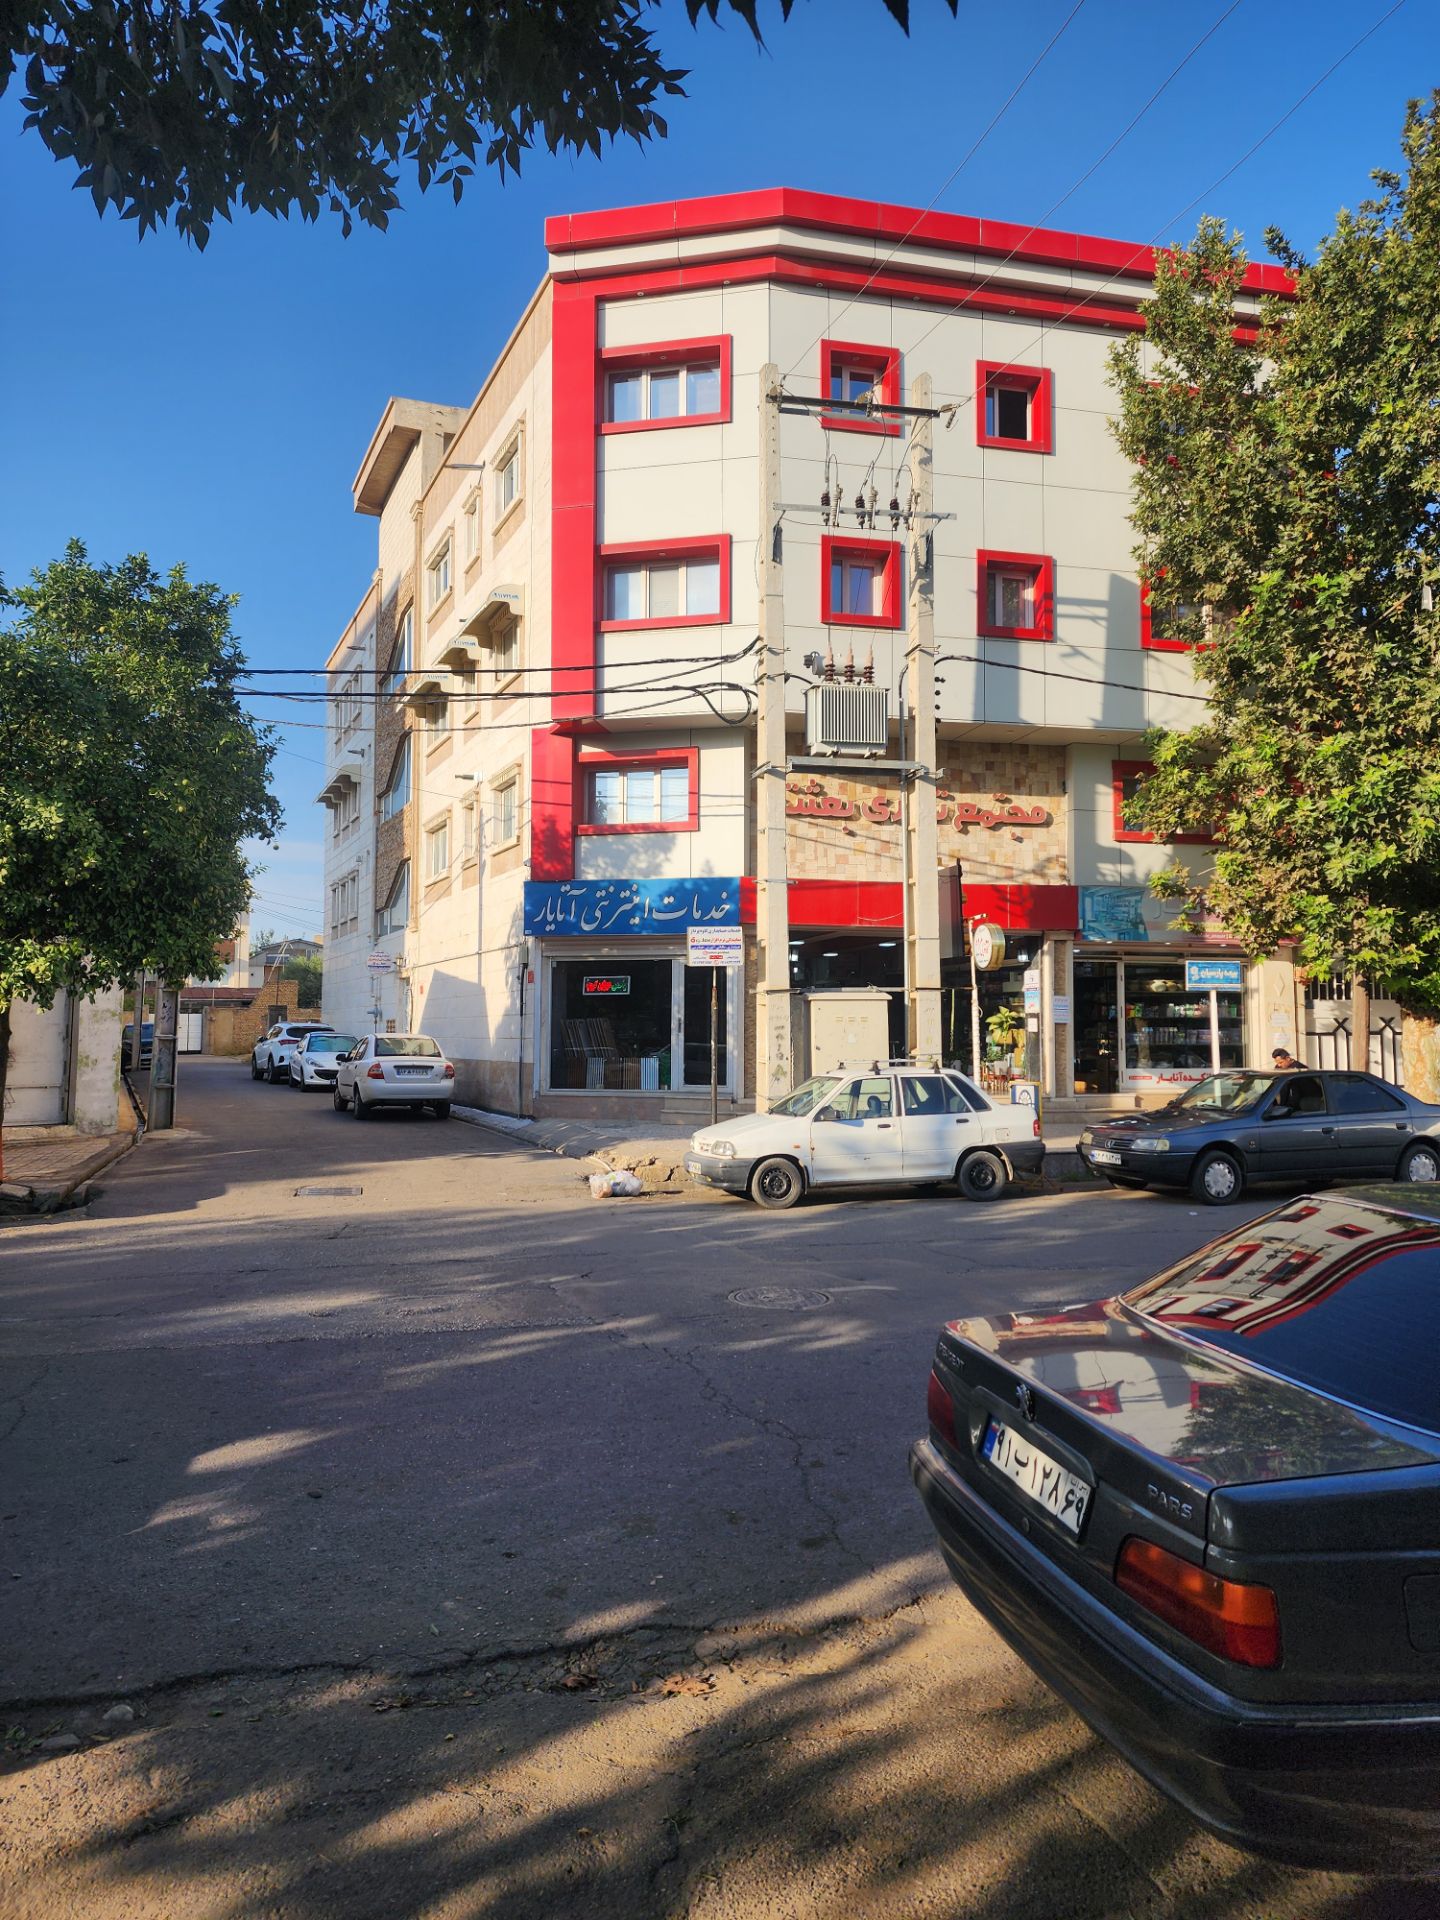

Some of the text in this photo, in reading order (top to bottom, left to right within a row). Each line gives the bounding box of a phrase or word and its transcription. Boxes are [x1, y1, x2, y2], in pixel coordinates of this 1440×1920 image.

[953, 793, 1047, 841] مجتمع
[580, 883, 650, 931] اینترنتی
[652, 891, 731, 921] خدمات
[1148, 1483, 1193, 1521] PARS
